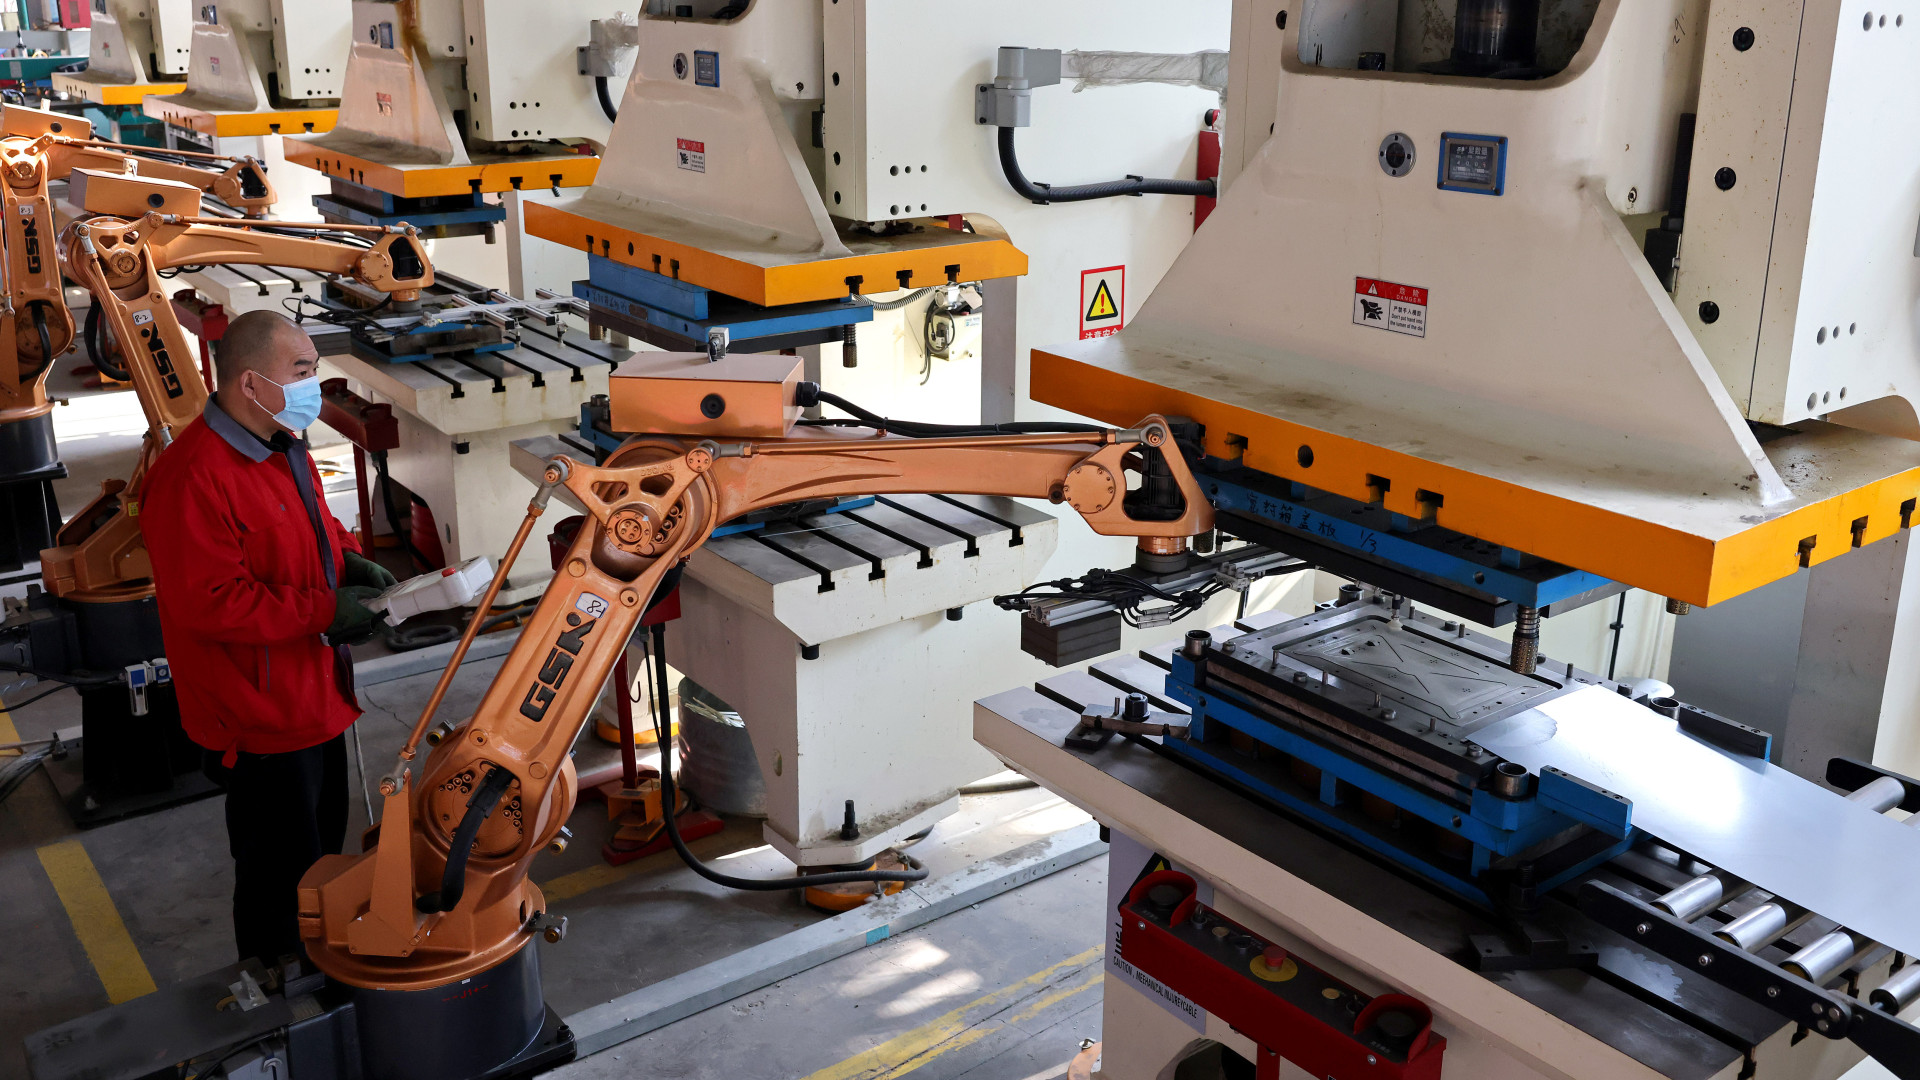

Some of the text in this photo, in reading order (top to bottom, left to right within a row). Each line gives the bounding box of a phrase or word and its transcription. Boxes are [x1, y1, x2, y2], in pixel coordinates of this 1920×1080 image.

[22, 217, 42, 274] GSK
[1396, 294, 1422, 303] DANGER
[1399, 286, 1420, 298] 危险
[141, 321, 184, 399] GSK
[519, 612, 597, 723] GSK
